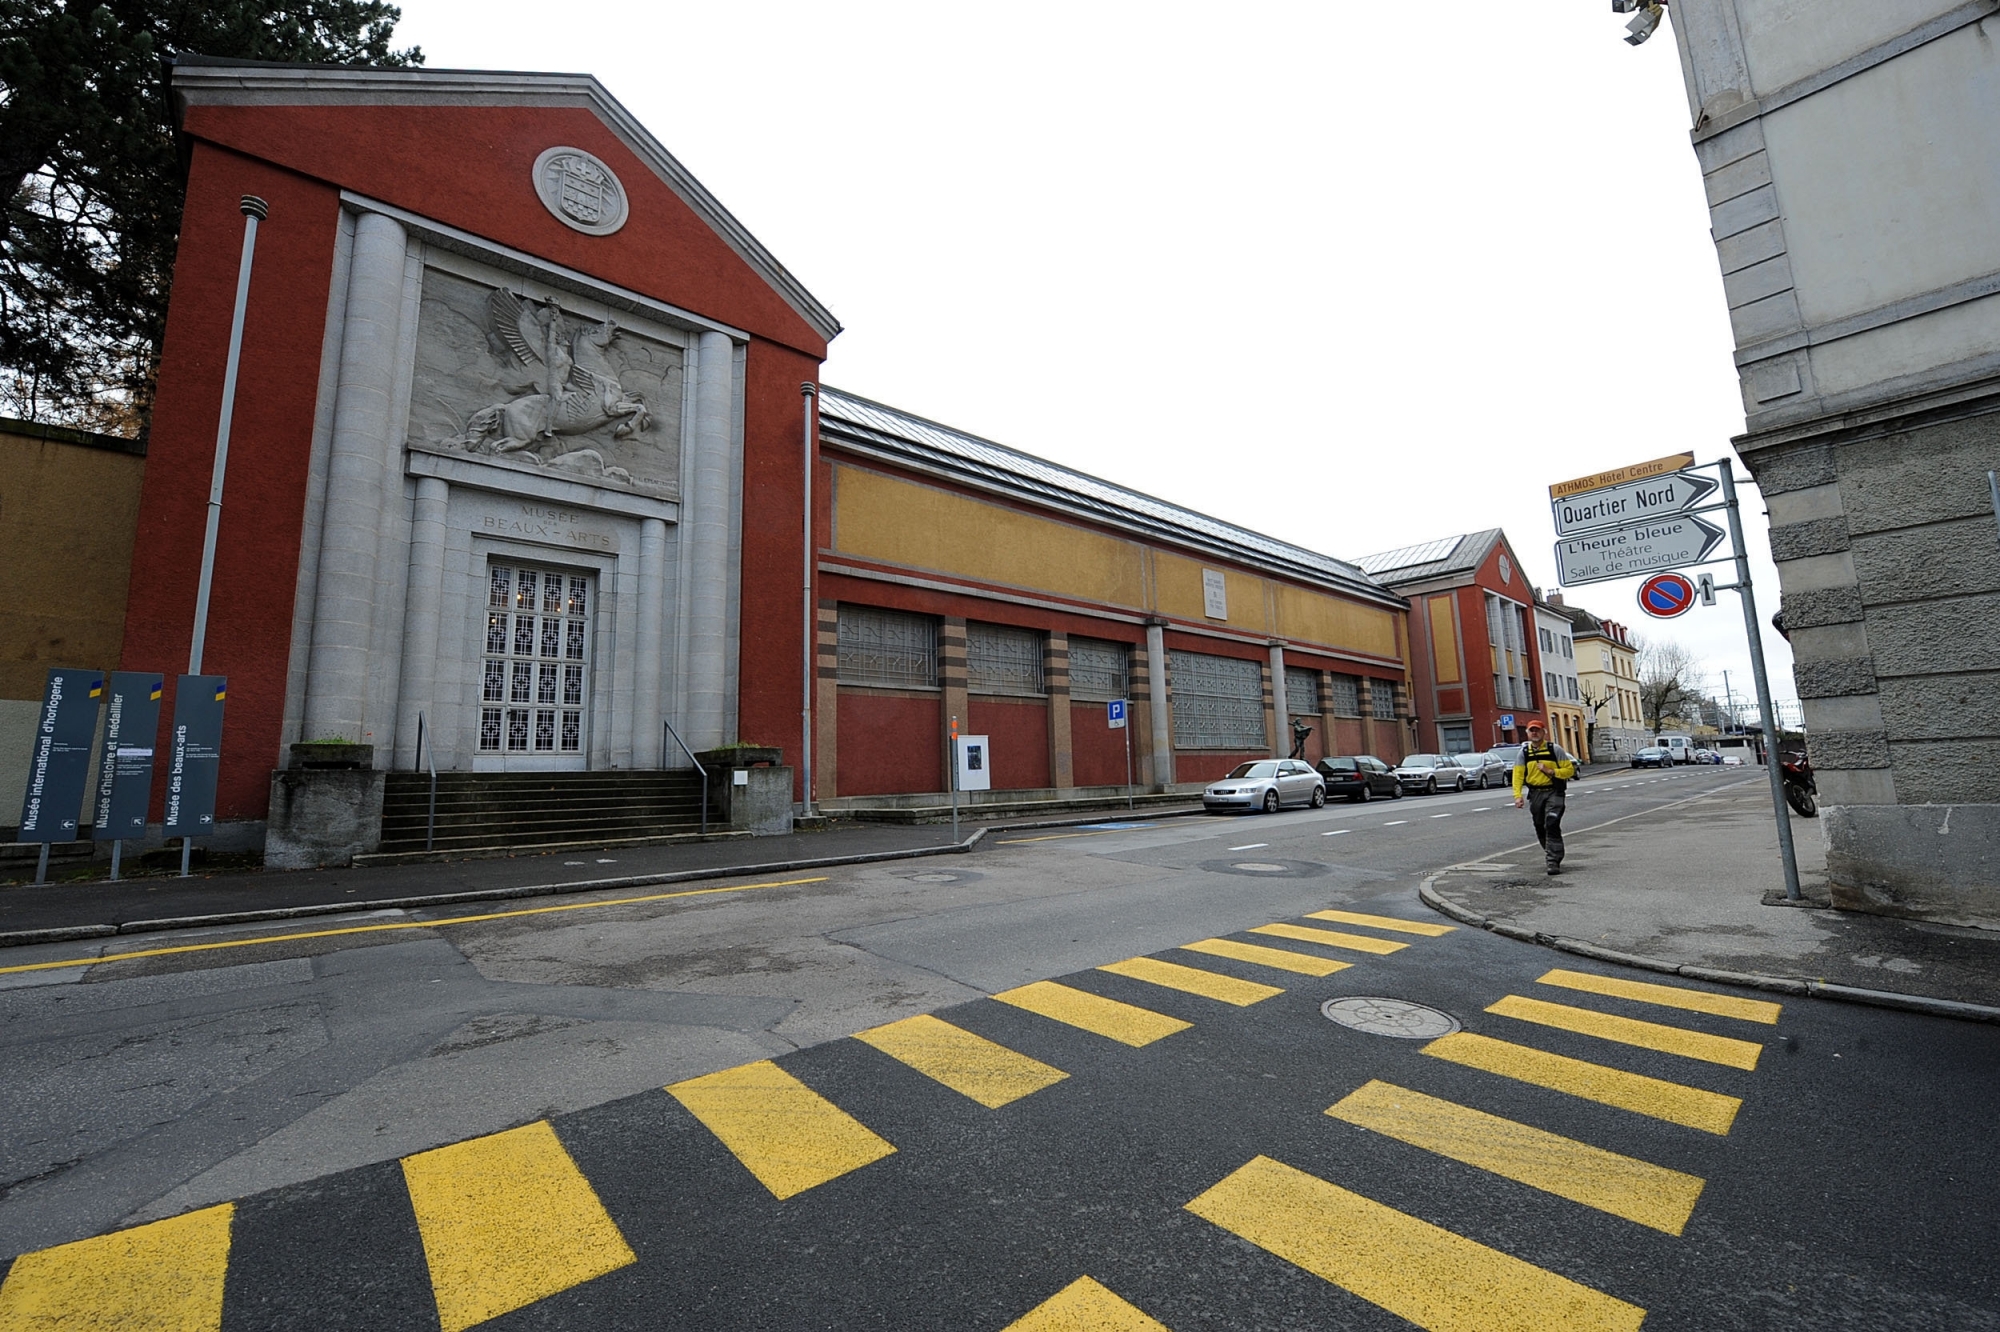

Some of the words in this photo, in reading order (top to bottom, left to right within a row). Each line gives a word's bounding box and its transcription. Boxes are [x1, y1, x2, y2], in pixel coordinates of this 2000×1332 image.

[1557, 479, 1595, 495] ATHMOS
[1599, 470, 1625, 484] Hôtel
[1630, 462, 1663, 477] Centre
[1563, 497, 1627, 524] Quartier
[1636, 484, 1675, 508] Nord
[1568, 535, 1627, 554] L'heure
[1635, 524, 1683, 541] bleue
[1599, 543, 1653, 561] Théâtre
[1570, 565, 1600, 579] Salle
[1605, 561, 1623, 572] de
[1629, 549, 1689, 568] musique
[42, 676, 64, 733] d'horlogerie
[109, 693, 124, 738] médaillier
[1112, 704, 1120, 718] P
[1503, 716, 1509, 724] P
[109, 741, 117, 751] et
[172, 725, 187, 775] beaux-arts
[30, 736, 51, 797] international
[103, 752, 116, 796] d'histoire
[170, 776, 181, 793] des
[24, 798, 41, 831] Musée
[96, 797, 111, 829] Musée
[167, 796, 179, 826] Musée
